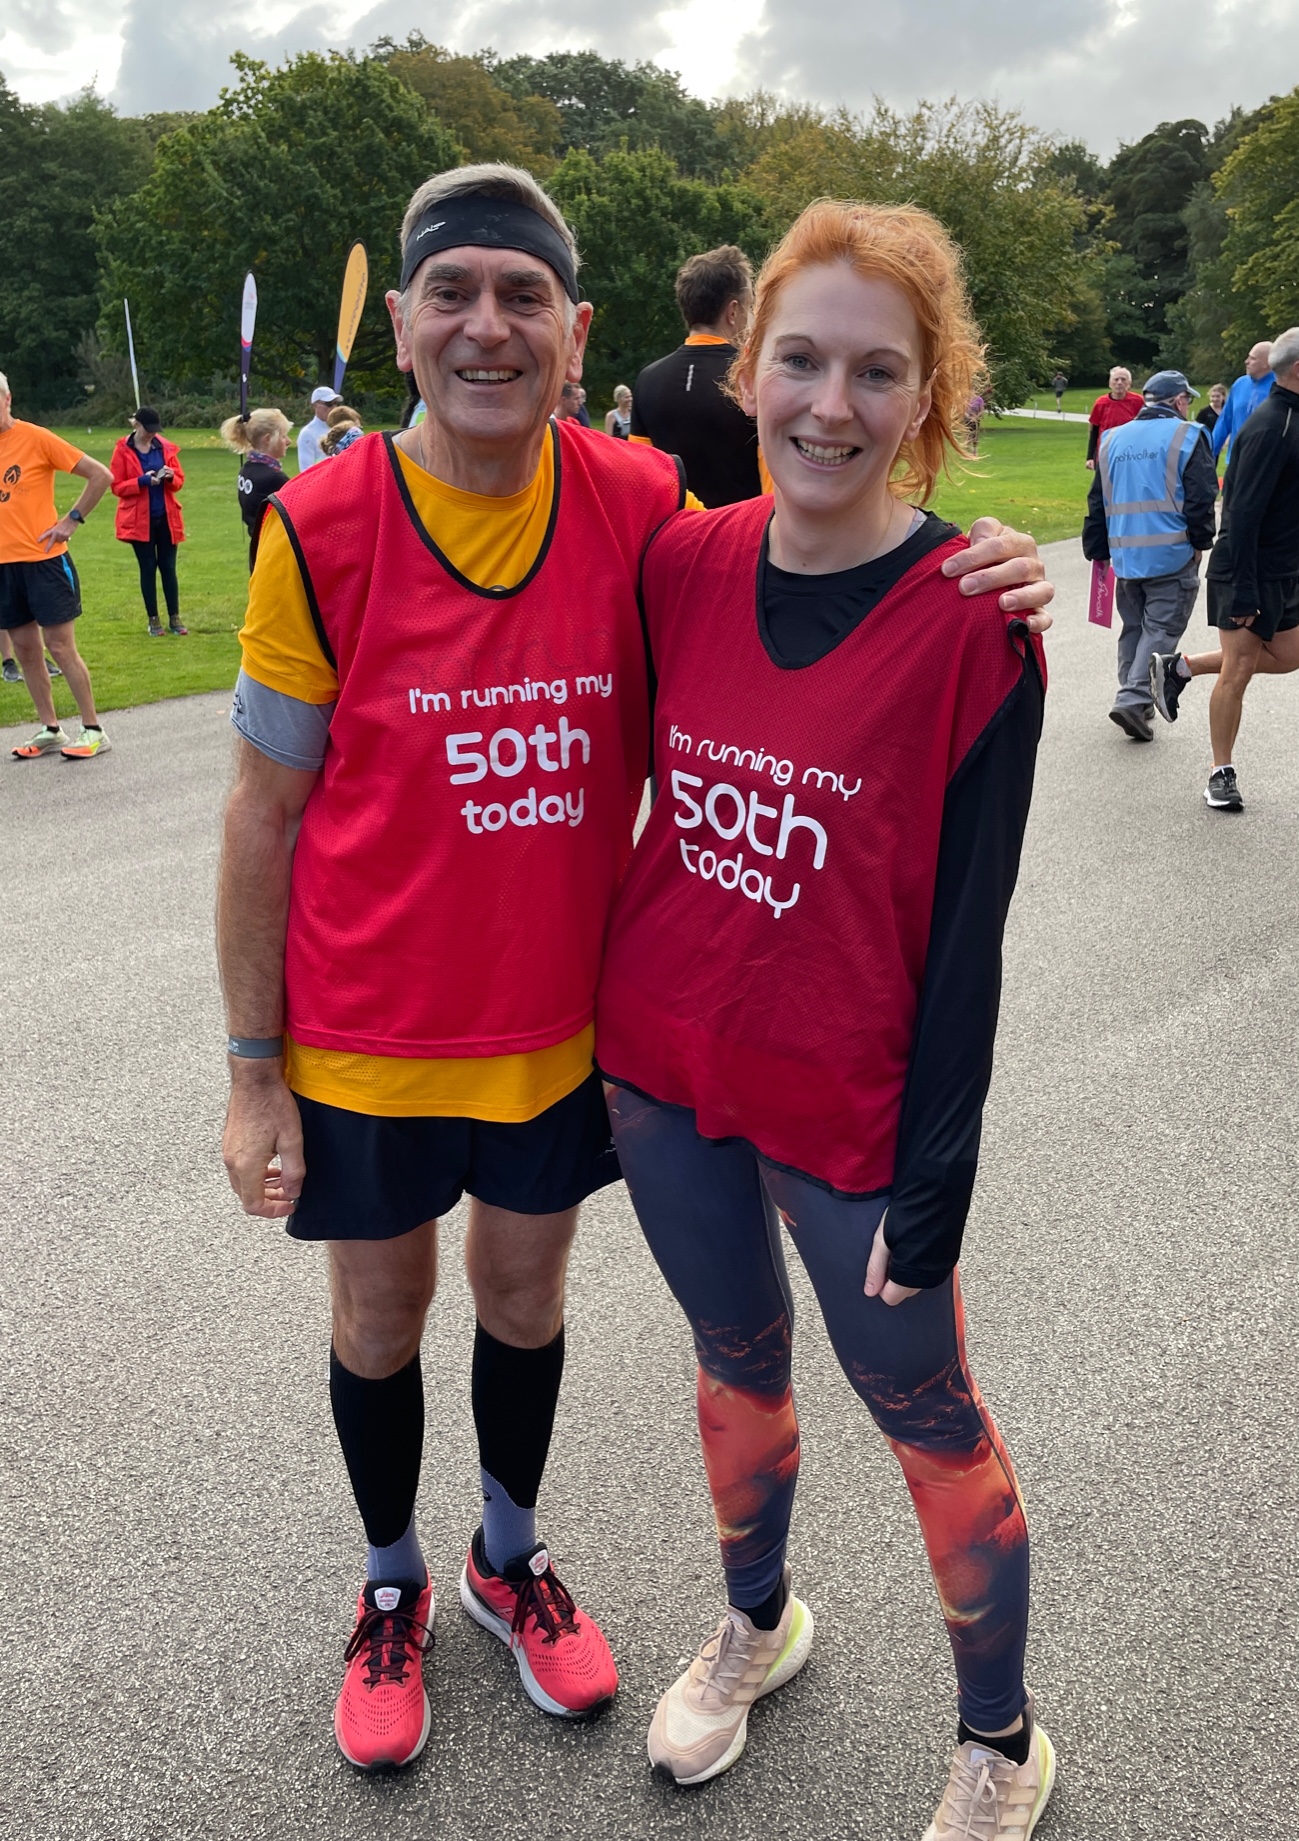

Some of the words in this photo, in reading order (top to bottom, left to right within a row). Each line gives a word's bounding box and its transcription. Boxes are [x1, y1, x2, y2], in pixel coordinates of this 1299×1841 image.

[409, 688, 451, 714] I'm
[461, 677, 568, 709] running
[576, 673, 613, 698] my
[446, 716, 591, 785] 50th
[669, 725, 692, 753] I'm
[696, 739, 794, 786] running
[802, 767, 862, 801] my
[461, 787, 584, 834] today
[671, 769, 828, 870] 50th
[680, 838, 800, 919] today
